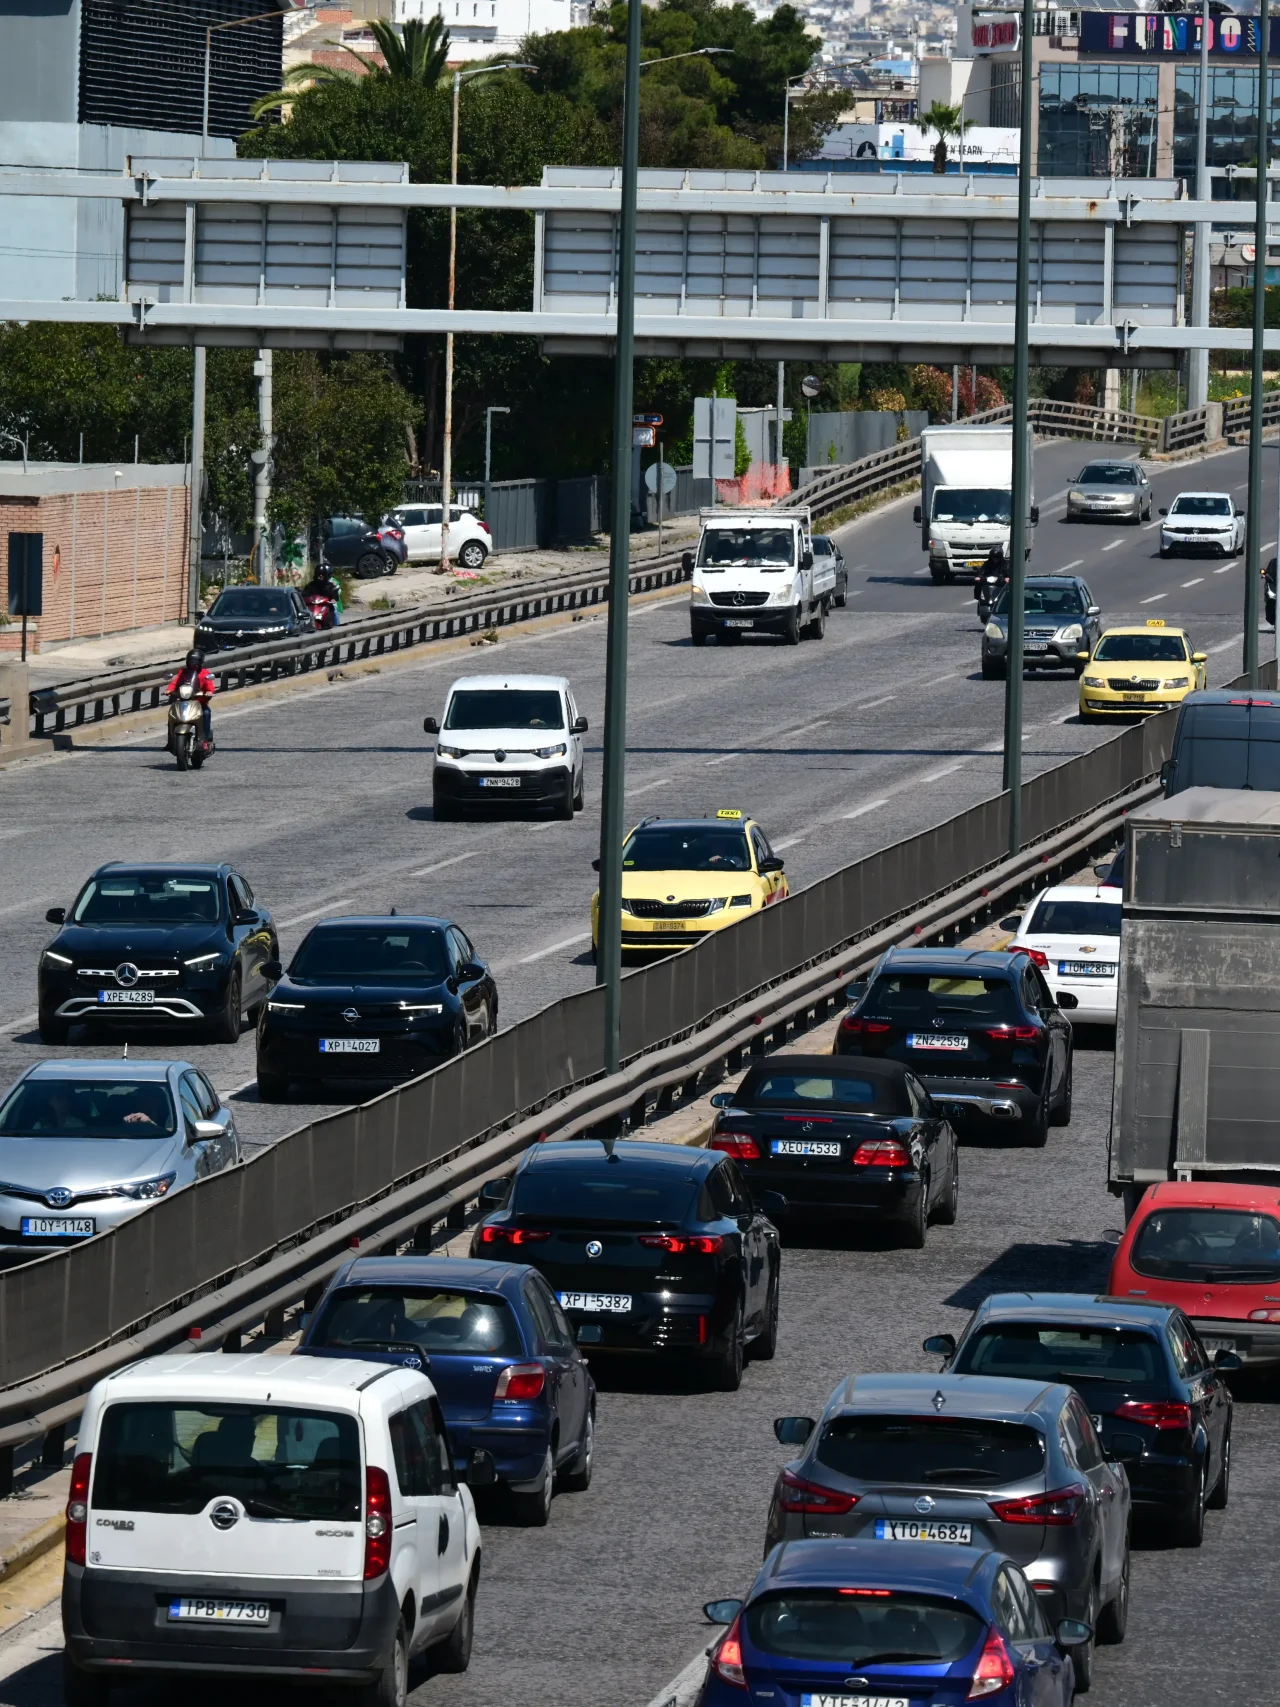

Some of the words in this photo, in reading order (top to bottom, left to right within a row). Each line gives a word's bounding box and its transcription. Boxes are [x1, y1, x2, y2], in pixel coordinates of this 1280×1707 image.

[107, 992, 153, 1002] XPE-4289
[328, 1041, 377, 1052] XPI-4027
[915, 1035, 967, 1047] ZNZ-2594
[781, 1141, 838, 1154] XEO-4533
[34, 1219, 92, 1233] IOY-1148
[565, 1293, 630, 1309] XPI-5382
[97, 1519, 135, 1528] COMBO
[186, 1600, 268, 1619] IPB-7730
